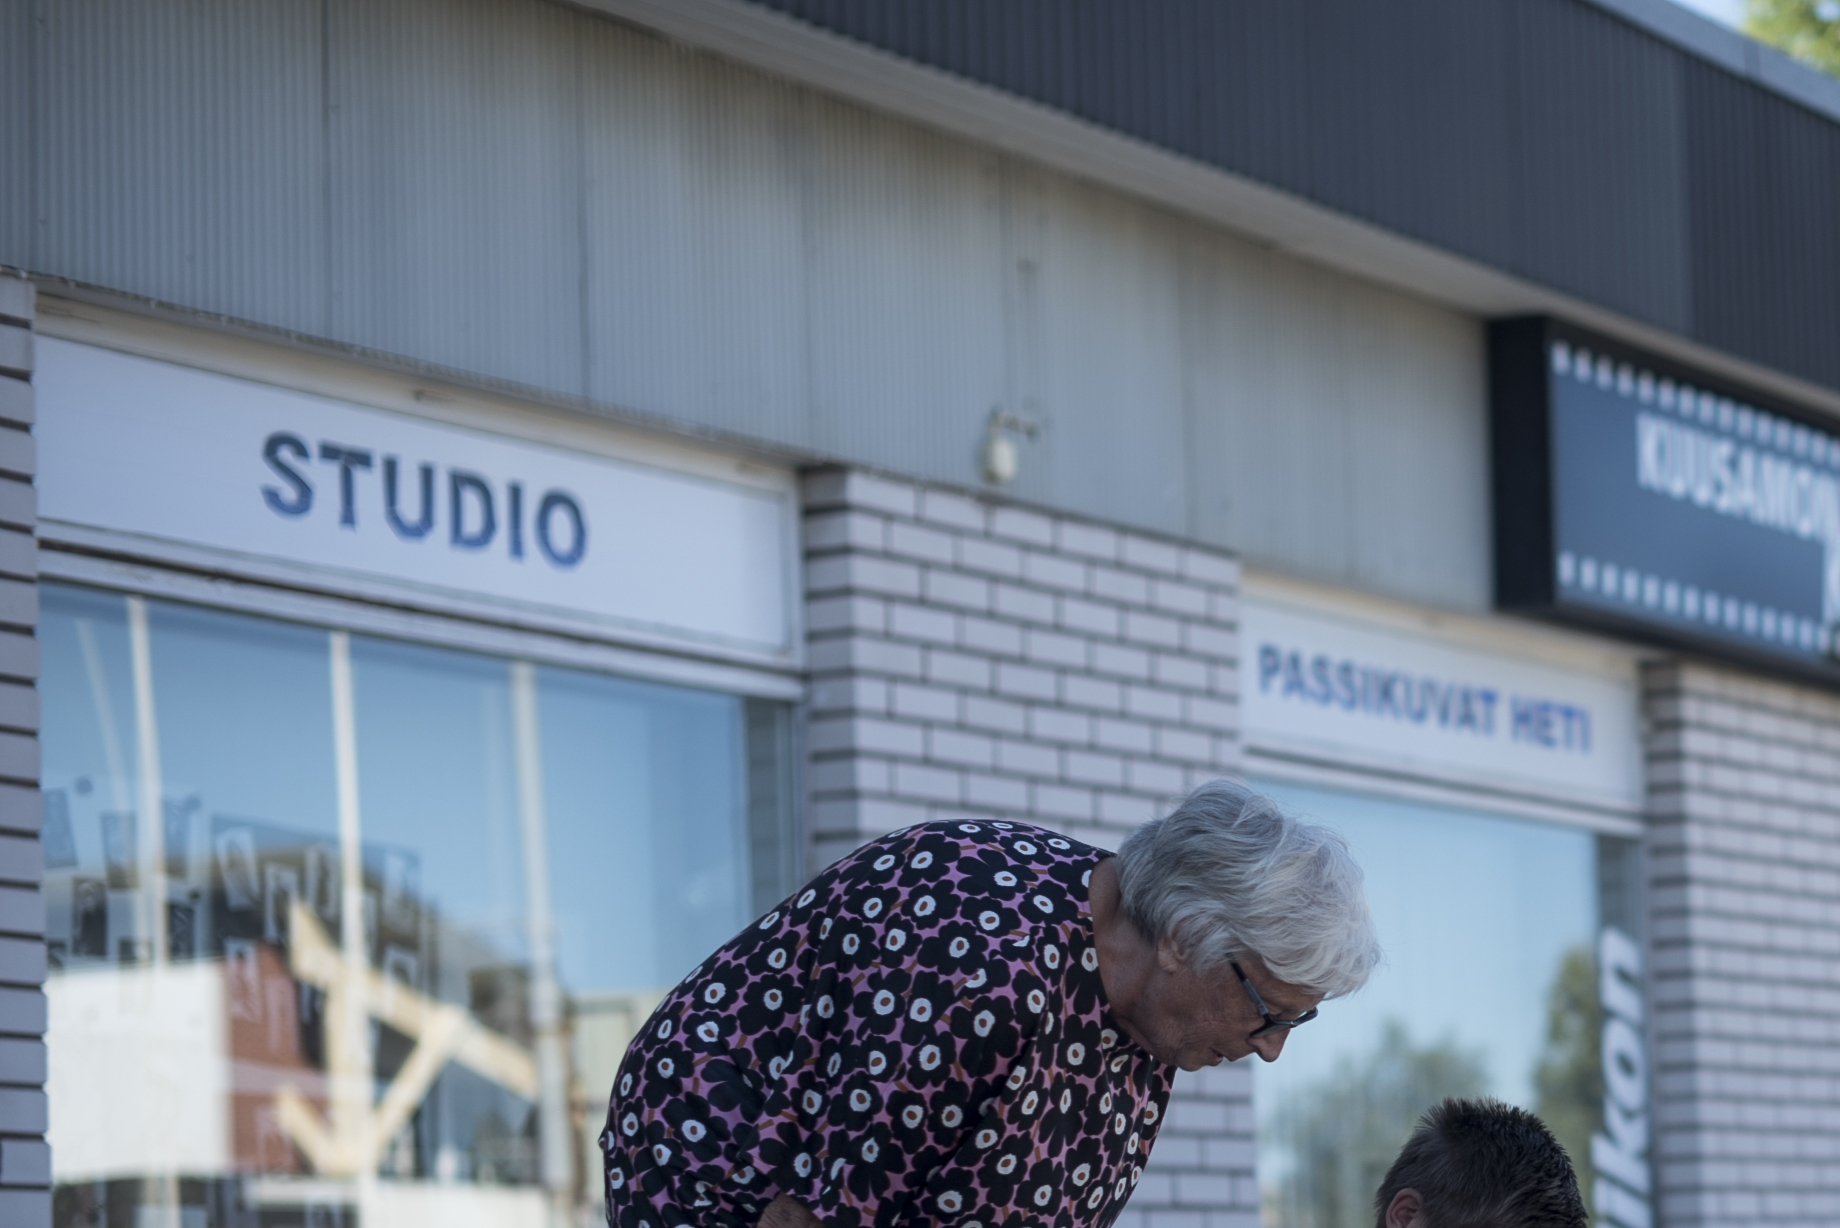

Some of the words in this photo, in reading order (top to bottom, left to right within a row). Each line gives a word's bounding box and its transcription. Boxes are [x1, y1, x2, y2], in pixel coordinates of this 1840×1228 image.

[260, 430, 588, 572] STUDIO
[1256, 642, 1500, 737] PASSIKUVAT
[1509, 692, 1593, 755] HETI
